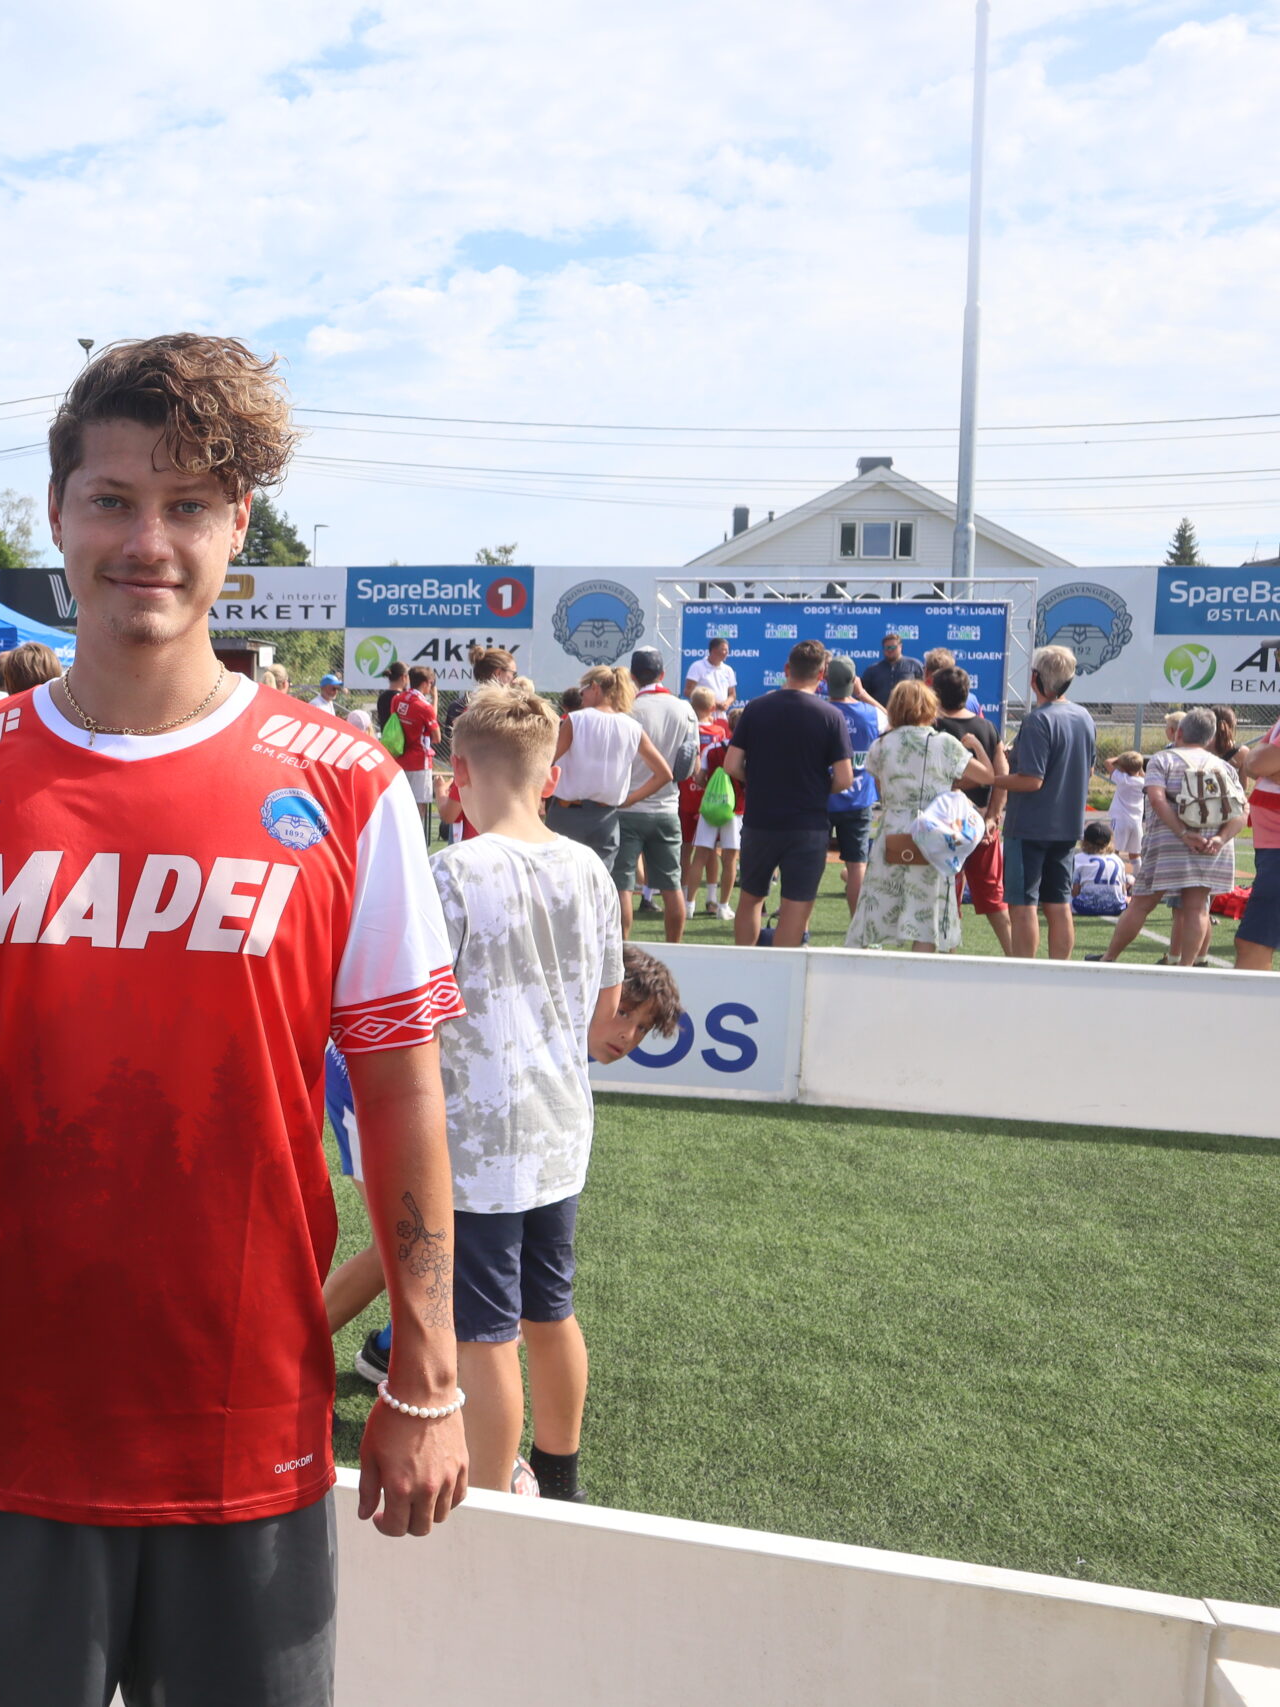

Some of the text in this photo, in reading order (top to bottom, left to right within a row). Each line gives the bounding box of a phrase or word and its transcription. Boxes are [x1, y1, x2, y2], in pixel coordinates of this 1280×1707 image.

[282, 592, 338, 601] interiør
[356, 578, 513, 610] SpareBank 1
[566, 583, 625, 602] KONGSVINGER
[1044, 585, 1111, 606] KONGSVINGER
[208, 604, 338, 620] ARKETT
[388, 603, 482, 616] ØSTLANDET
[685, 606, 761, 615] OBOS LIGAEN
[803, 606, 881, 615] OBOS LIGAEN
[925, 607, 1005, 616] OBOS LIGAEN
[583, 639, 609, 649] 1892
[728, 649, 760, 658] LIGAEN
[846, 650, 880, 659] LIGAEN
[967, 651, 1002, 661] LIGAEN
[1230, 679, 1280, 693] BEM
[276, 752, 310, 770] FJELD
[284, 828, 305, 839] 1892
[1089, 857, 1120, 886] 22
[274, 1452, 314, 1474] QUICKDRY
